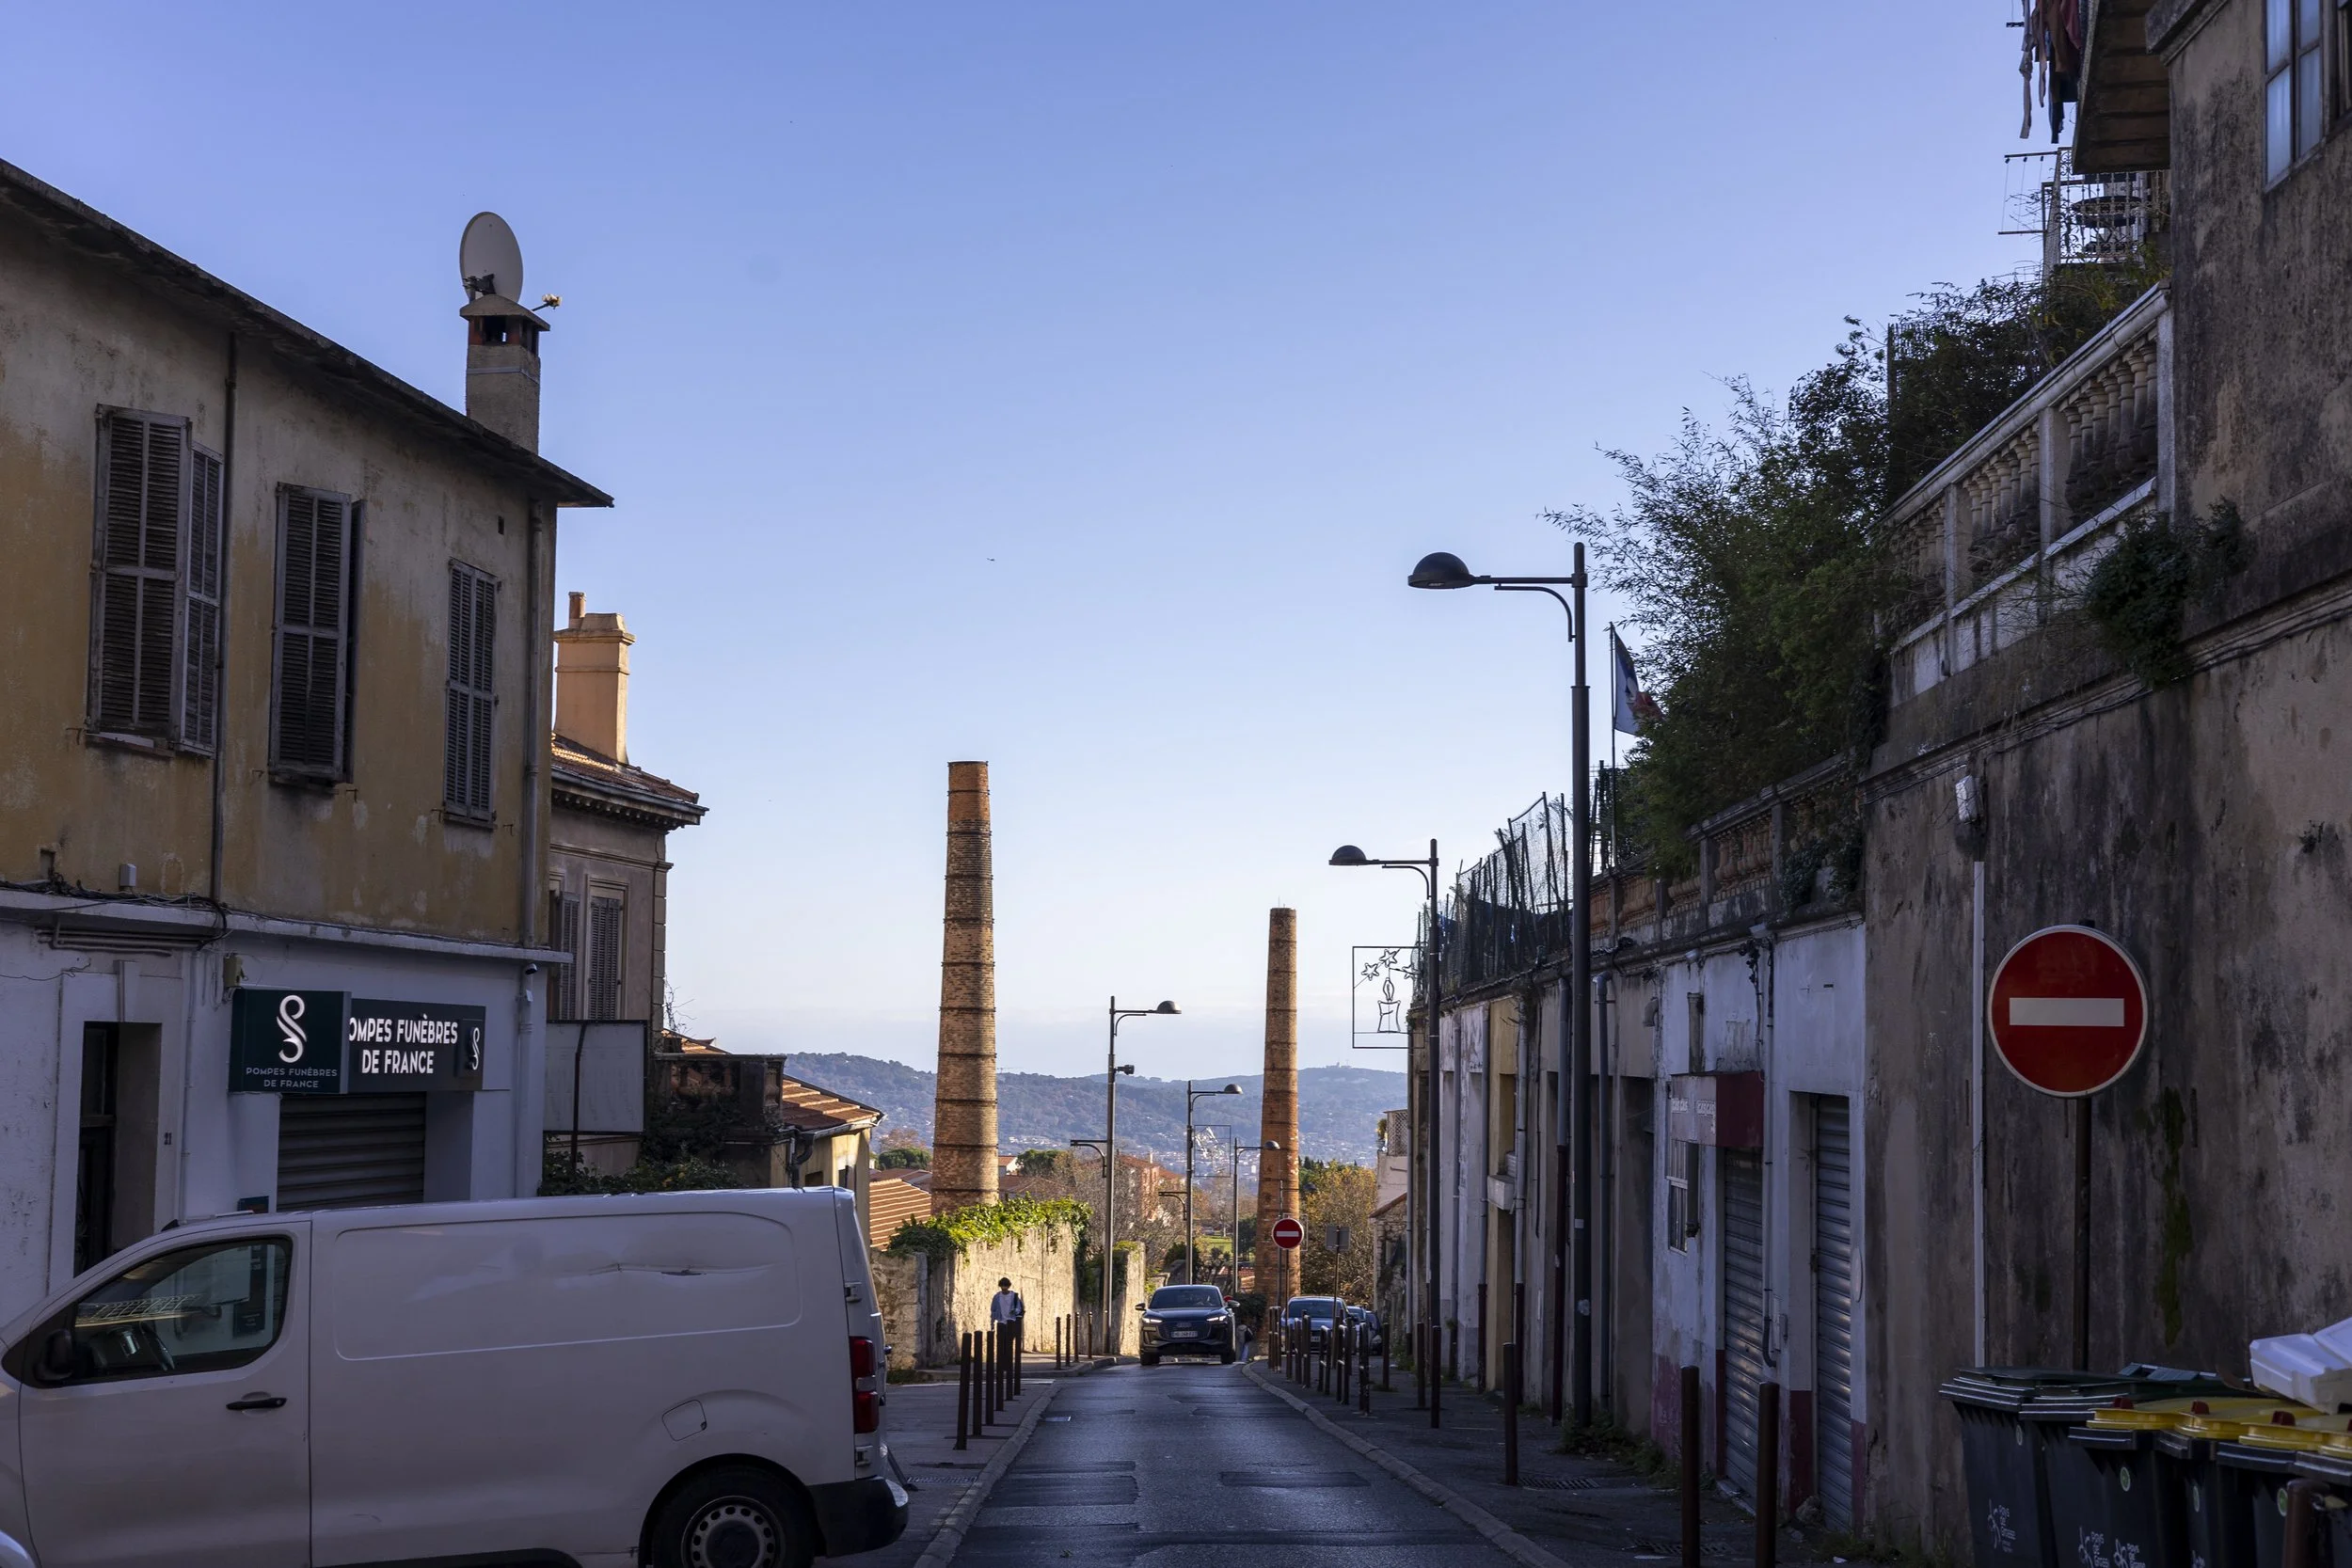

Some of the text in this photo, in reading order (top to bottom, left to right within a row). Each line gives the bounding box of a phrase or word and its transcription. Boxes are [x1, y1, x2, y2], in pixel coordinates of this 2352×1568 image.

[349, 1013, 458, 1044] OMPES FUNÈBRES
[361, 1049, 435, 1074] DE FRANCE
[246, 1067, 286, 1076] POMPES
[263, 1079, 319, 1088] DE FRANCE
